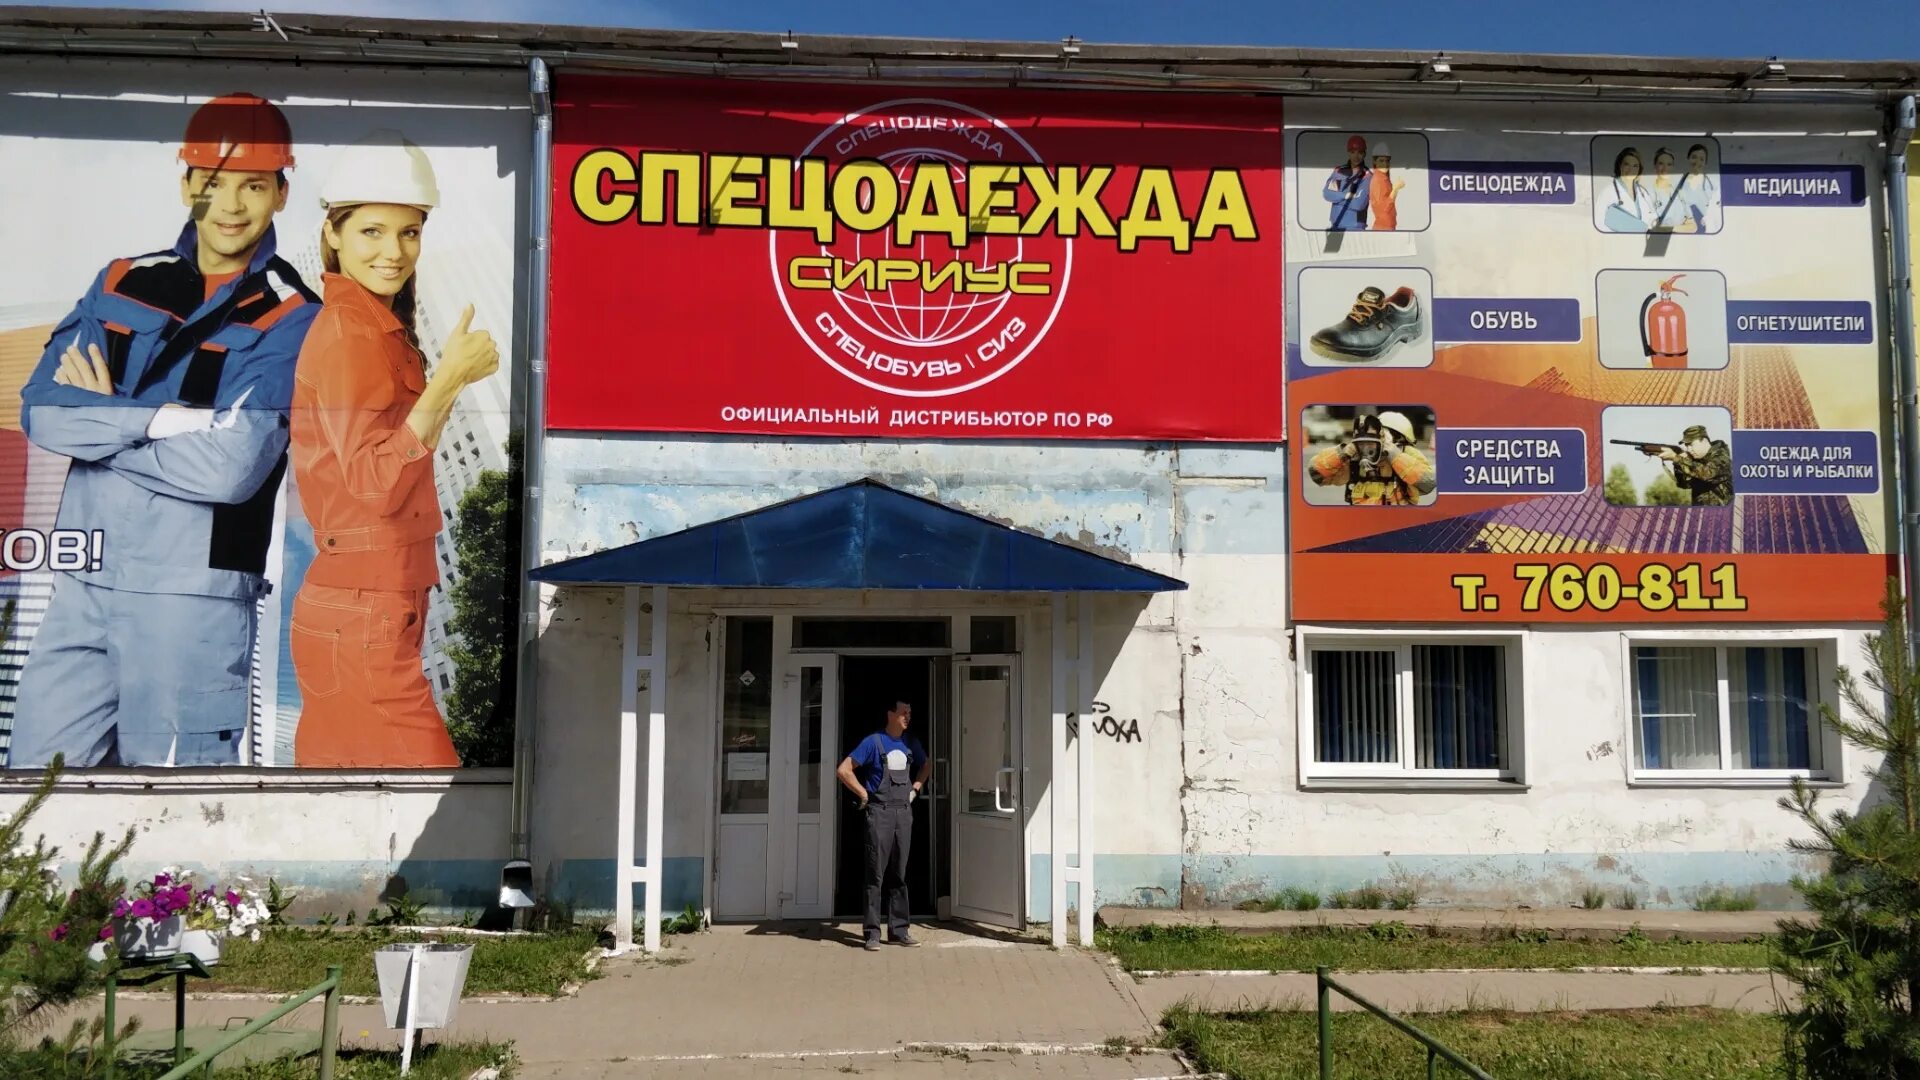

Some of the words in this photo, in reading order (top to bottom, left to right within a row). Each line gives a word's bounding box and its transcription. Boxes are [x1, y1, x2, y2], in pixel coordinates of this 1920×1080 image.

[835, 115, 1004, 158] СПЕЦОДЕЖДА
[1439, 174, 1567, 195] СПЕЦОДЕЖДА
[1743, 178, 1841, 197] МЕДИЦИНА
[572, 149, 1260, 252] СПЕЦОДЕЖДА
[788, 256, 1051, 295] СИРИУС
[1470, 310, 1537, 329] ОБУВЬ
[1737, 315, 1865, 332] ОГНЕТУШИТЕЛИ
[815, 311, 962, 378] СПЕЦОБУВЬ
[976, 316, 1027, 363] СИЗ
[721, 406, 879, 424] ОФИЦИАЛЬНЫЙ
[889, 410, 1048, 427] ДИСТРИБЬЮТОР
[1054, 412, 1081, 427] ПО
[1086, 412, 1113, 428] РФ
[1456, 439, 1562, 461] СРЕДСТВА
[1760, 446, 1820, 462] ОДЕЖДА
[1823, 446, 1852, 461] ДЛЯ
[1464, 465, 1555, 488] ЗАЩИТЫ
[1740, 464, 1789, 478] ОХОТЫ
[1793, 465, 1801, 478] И
[1806, 465, 1874, 478] РЫБАЛКИ
[0, 528, 104, 573] ОВ!
[1514, 561, 1748, 612] 760-811
